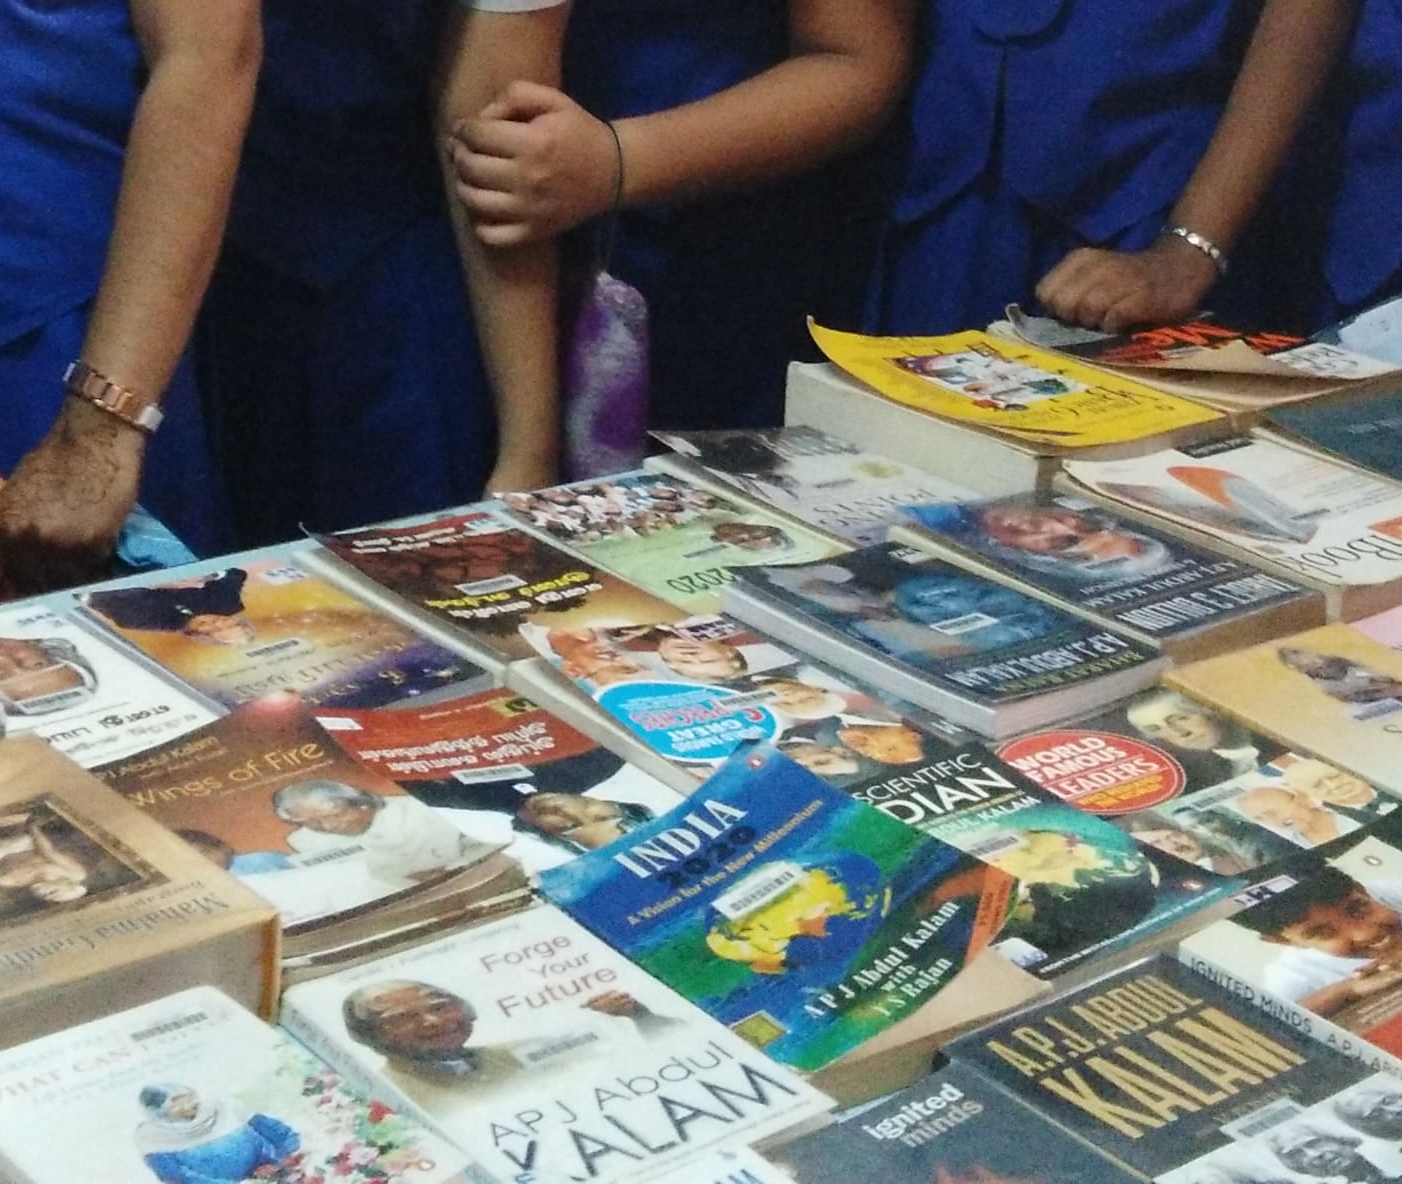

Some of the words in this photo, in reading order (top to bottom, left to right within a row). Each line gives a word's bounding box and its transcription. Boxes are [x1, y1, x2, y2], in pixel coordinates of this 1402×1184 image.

[666, 566, 737, 594] 2020
[126, 775, 222, 807] Wings
[229, 759, 259, 782] of
[264, 741, 325, 772] Fire
[854, 753, 983, 803] SCIENTIFIC
[1009, 736, 1106, 770] WORLD
[1026, 746, 1127, 783] FAMOUS
[878, 767, 1018, 825] DIAN
[1049, 758, 1161, 799] LEADERS
[978, 795, 1041, 824] KALAM
[613, 798, 747, 879] INDIA
[95, 892, 230, 941] Mahatma
[638, 887, 682, 922] Vision
[680, 878, 704, 901] for
[703, 866, 726, 892] the
[479, 935, 572, 974] Forge
[526, 951, 591, 979] Your
[804, 1002, 825, 1019] A
[819, 992, 838, 1010] P
[838, 983, 855, 1000] J
[852, 945, 907, 989] Abdul
[901, 900, 961, 952] Kalam
[880, 962, 916, 994] with
[900, 957, 953, 998] Rajan
[496, 966, 618, 1019] Future
[1188, 958, 1255, 1002] IGNITED
[1256, 995, 1313, 1035] MINDS
[72, 1047, 132, 1074] CAN
[592, 1039, 736, 1113] Abdul
[1040, 1007, 1308, 1139] KALAM
[502, 1062, 800, 1182] KALAM
[862, 1081, 965, 1140] ignited
[898, 1098, 985, 1148] minds
